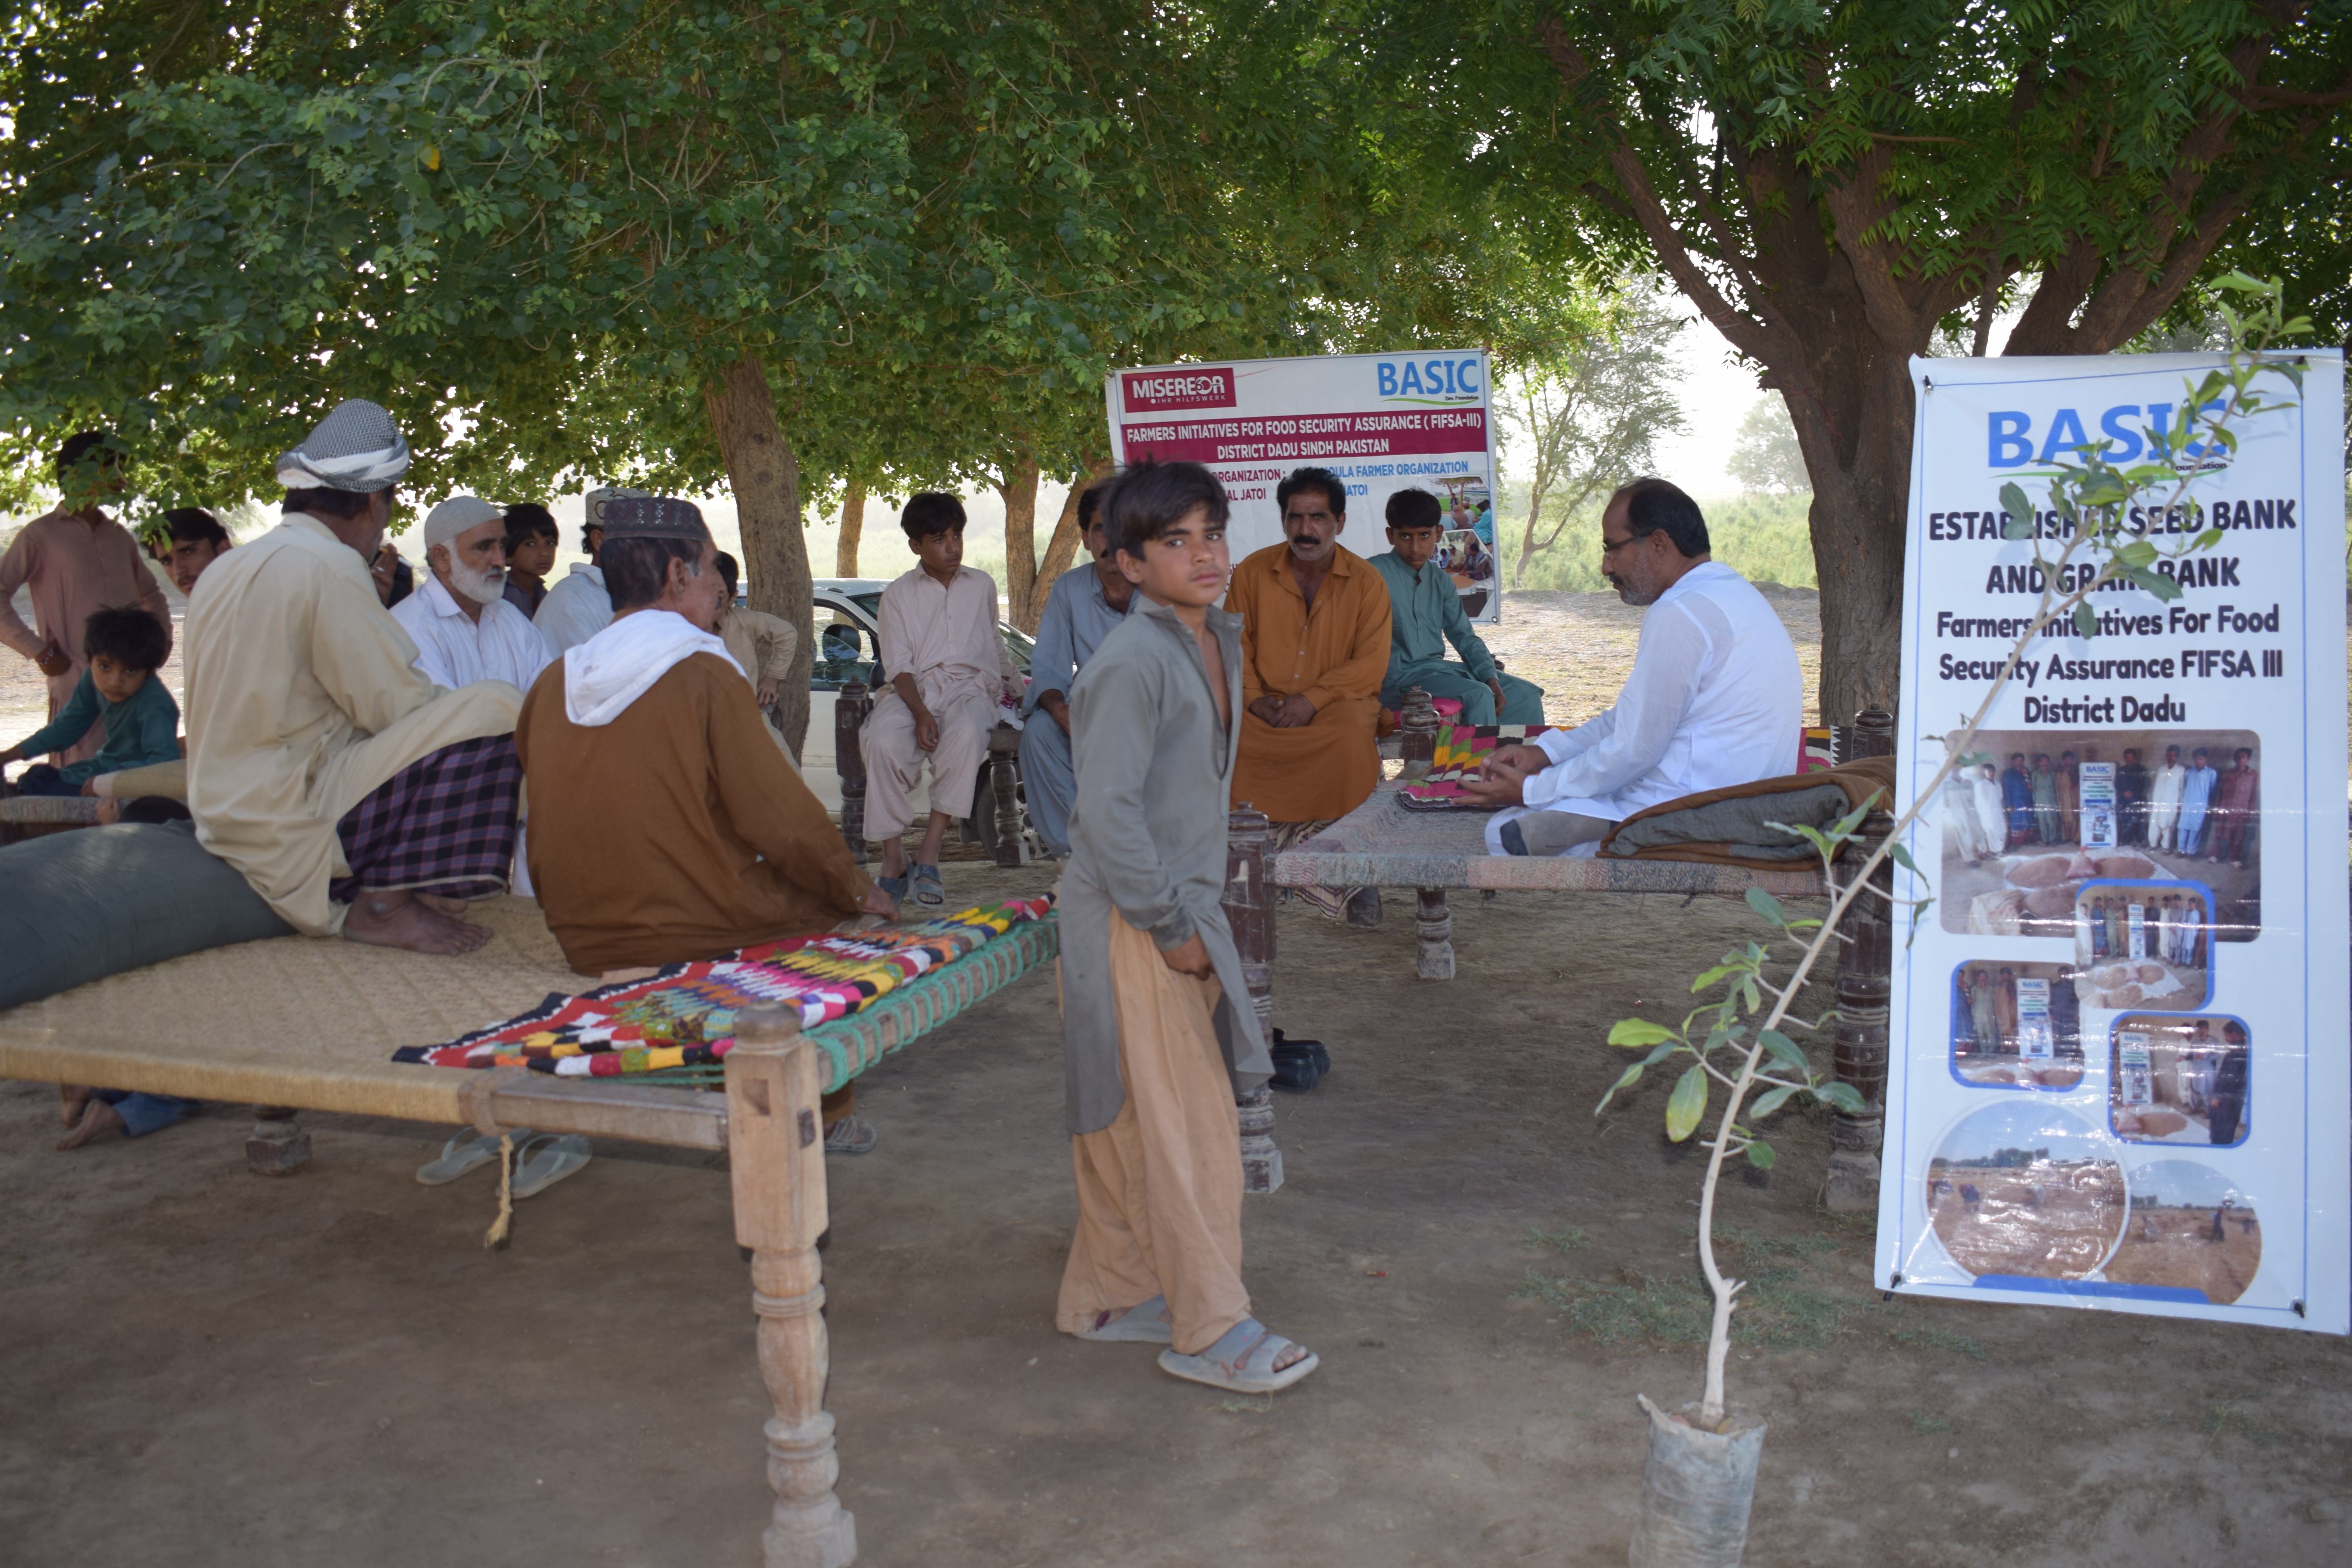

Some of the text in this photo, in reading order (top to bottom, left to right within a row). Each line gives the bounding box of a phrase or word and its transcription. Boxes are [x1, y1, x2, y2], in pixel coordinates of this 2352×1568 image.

[1132, 376, 1225, 398] MISEREOR
[1377, 359, 1478, 396] BASIC
[1126, 426, 1176, 443] FARMERS
[1178, 423, 1240, 439] INITIATIVES
[1241, 421, 1263, 436] FOR
[1265, 420, 1297, 436] FOOD
[1299, 417, 1352, 434] SECURITY
[1354, 415, 1421, 432] ASSURANCE
[1430, 413, 1481, 429] FIFSA-III)
[1217, 438, 1390, 459] DISTRICT DADU SINDH PAKISTAN
[1322, 460, 1468, 478] OULA FARMER ORGANIZATION
[2171, 462, 2227, 471] ounation
[1240, 488, 1267, 501] JATOI
[1929, 499, 2297, 541] ESTAISH SEED BANK
[1985, 557, 2240, 594] AND GRA BANK
[1937, 603, 2279, 638] Farmers Inittives For Food
[2045, 653, 2175, 680] Assurance
[2181, 649, 2256, 678] FIFSA
[2262, 649, 2283, 678] III
[2024, 693, 2186, 724] District Dadu
